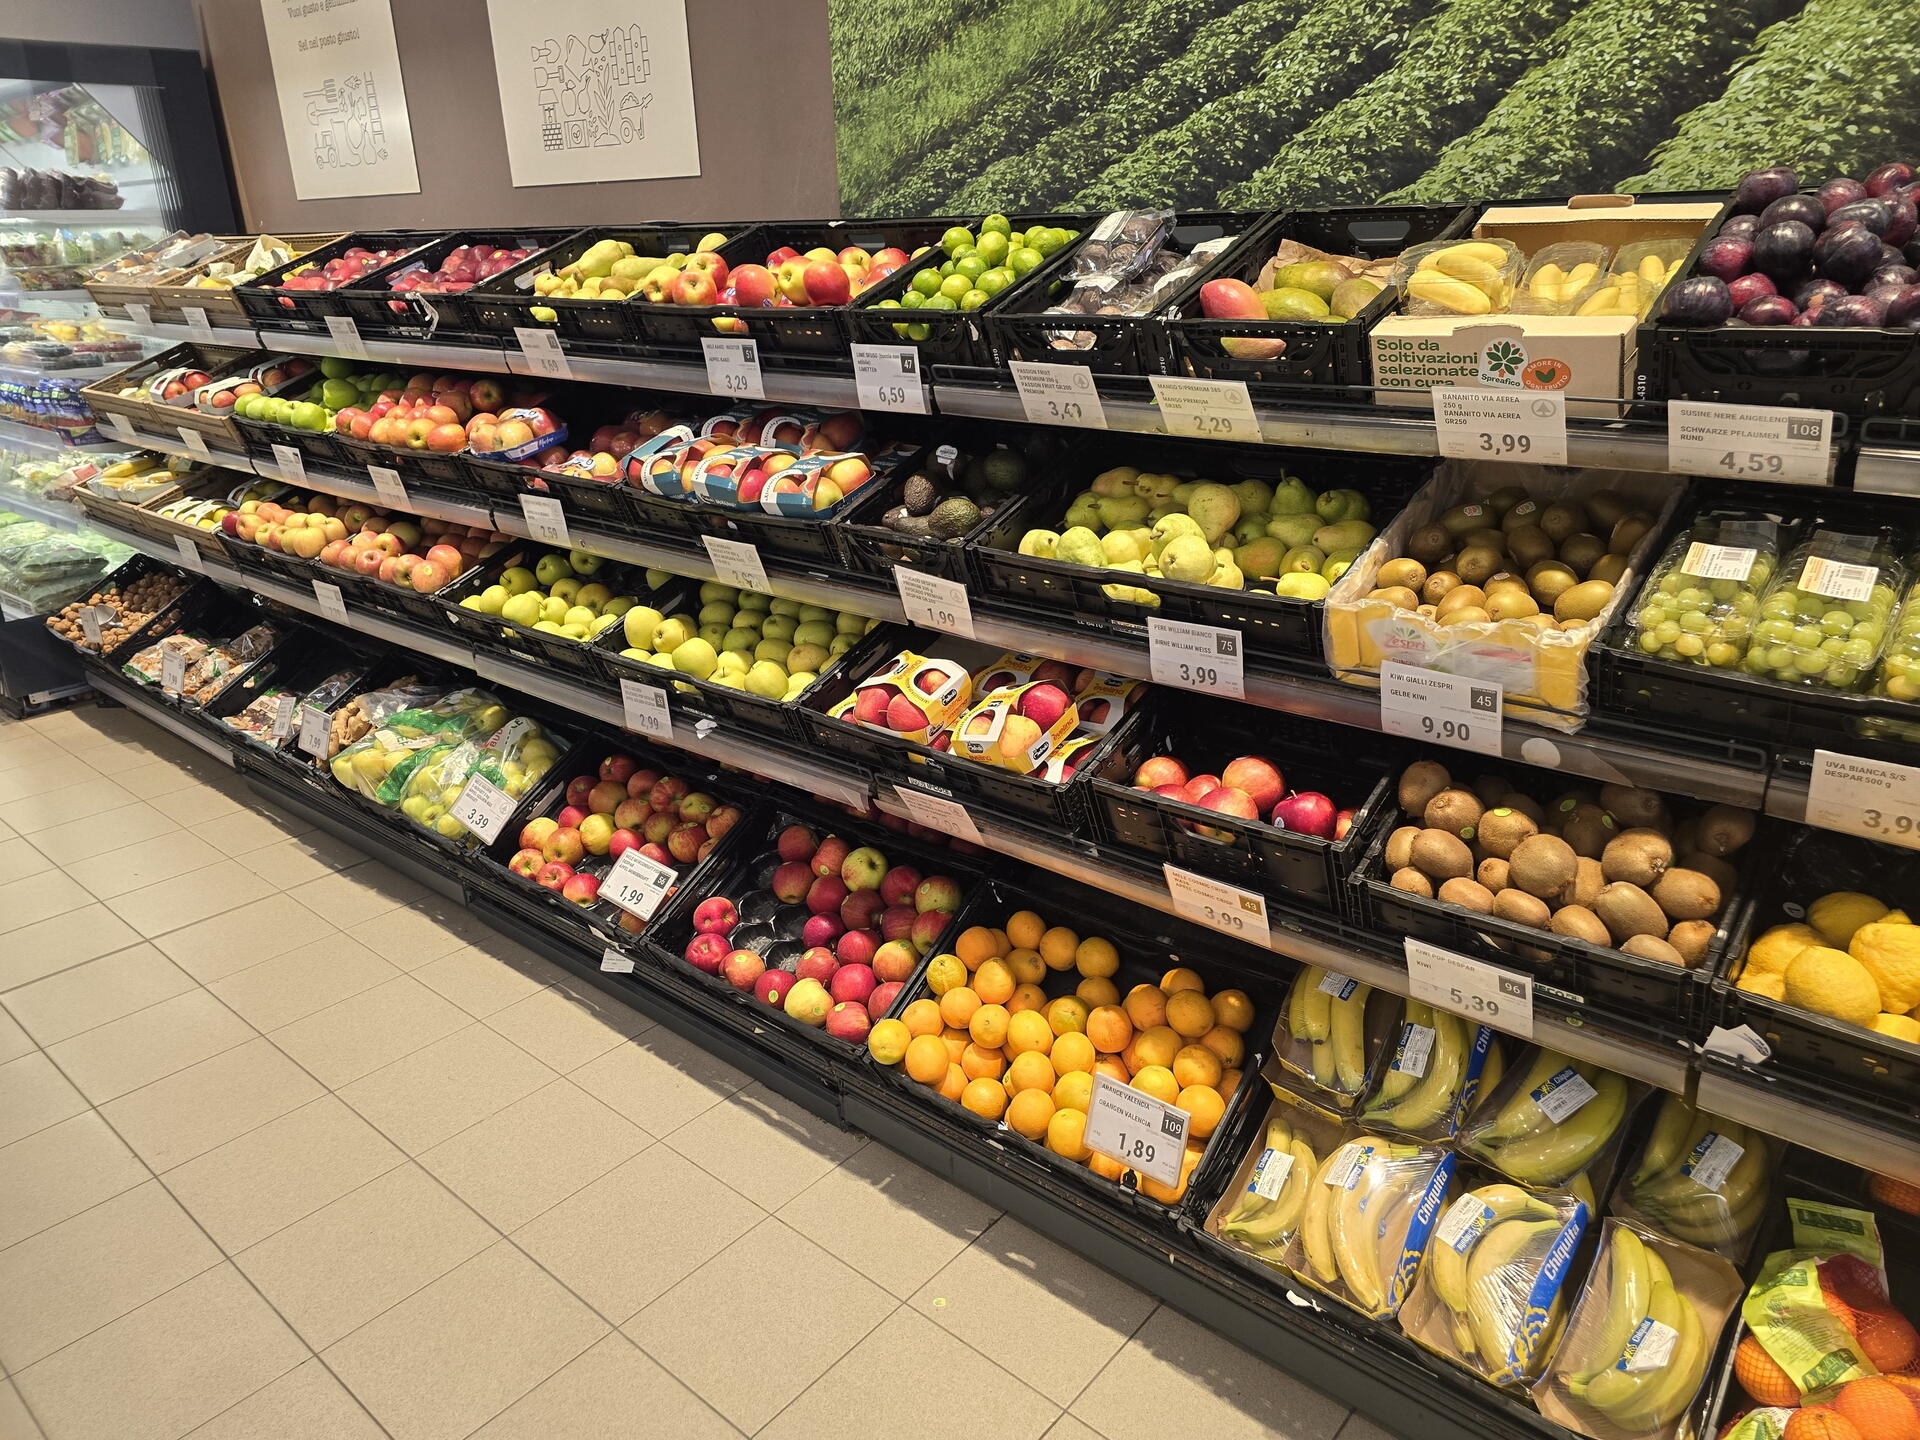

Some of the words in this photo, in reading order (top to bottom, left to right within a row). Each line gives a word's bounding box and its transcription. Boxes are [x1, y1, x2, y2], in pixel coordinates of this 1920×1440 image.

[319, 33, 336, 49] posto
[337, 28, 360, 45] giusto!
[1377, 338, 1414, 351] Solo
[1418, 338, 1439, 351] da
[904, 359, 912, 369] 47
[1378, 352, 1478, 364] coltivazioni
[1379, 364, 1479, 377] selezionate
[1526, 360, 1551, 374] AMORE
[1552, 360, 1562, 368] IN
[726, 374, 748, 392] 3,29
[1380, 376, 1411, 387] con
[1481, 373, 1521, 388] Spreafico
[878, 386, 905, 406] 6,59
[1444, 410, 1480, 418] BANANITO
[1498, 412, 1521, 420] AEREA
[1680, 410, 1712, 418] SUSINE
[1713, 412, 1736, 420] NERE
[1739, 414, 1788, 423] ANGELENO
[1194, 416, 1232, 434] 2,29
[1680, 426, 1728, 435] SCHWARZE
[1730, 430, 1780, 439] PFLAUMEN
[1791, 424, 1820, 436] 108
[1479, 432, 1531, 455] 3,99
[1720, 452, 1783, 474] 4,59
[904, 586, 923, 595] AVOCADO
[924, 591, 943, 600] PREMIUM
[927, 608, 955, 626] 1,99
[1154, 624, 1167, 632] PERE
[1168, 626, 1190, 636] WILLIAM
[1191, 630, 1212, 638] BIANCO
[1155, 638, 1170, 646] BIRNE
[1171, 642, 1194, 651] WILLIAM
[1194, 646, 1212, 654] WEISS
[1220, 640, 1233, 652] 75
[1384, 632, 1426, 650] Zespri
[1180, 663, 1217, 686] 3,99
[1390, 672, 1404, 680] KIWI
[1406, 676, 1427, 686] GIALLI
[1428, 680, 1453, 690] ZESPRI
[1390, 688, 1411, 698] GELBE
[1412, 693, 1428, 702] KIWI
[1476, 695, 1492, 708] 45
[640, 713, 659, 730] 2,99
[1421, 716, 1470, 742] 9,90
[1824, 769, 1863, 782] DESPAR
[1864, 777, 1882, 786] 500
[1826, 760, 1846, 770] UVA
[1848, 765, 1886, 778] BIANCA
[1889, 772, 1907, 782] S/S
[468, 808, 489, 829] 3,39
[657, 876, 667, 886] 56
[1172, 872, 1187, 881] MELE
[1188, 877, 1210, 888] COSMIC
[1211, 885, 1228, 894] CRISP
[619, 885, 644, 905] 1,99
[1194, 889, 1216, 900] COSMIC
[1216, 897, 1234, 906] CRISP
[1244, 902, 1257, 912] 43
[1204, 906, 1244, 930] 3,99
[1415, 948, 1431, 958] KIWI
[1432, 954, 1446, 963] POP
[1448, 959, 1476, 972] DESPAR
[1416, 960, 1432, 970] KIWI
[1504, 982, 1521, 994] 96
[1450, 988, 1500, 1016] 5,39
[1554, 1069, 1574, 1084] Chiquita
[1102, 1083, 1122, 1098] ARANCE
[1123, 1093, 1150, 1110] VALENCIA
[1098, 1098, 1124, 1116] ORANGEN
[1124, 1110, 1152, 1128] VALENCIA
[1164, 1119, 1182, 1134] 109
[1118, 1132, 1156, 1163] 1,89
[1416, 1168, 1448, 1226] Chiquita
[1544, 1222, 1580, 1281] Chiquita
